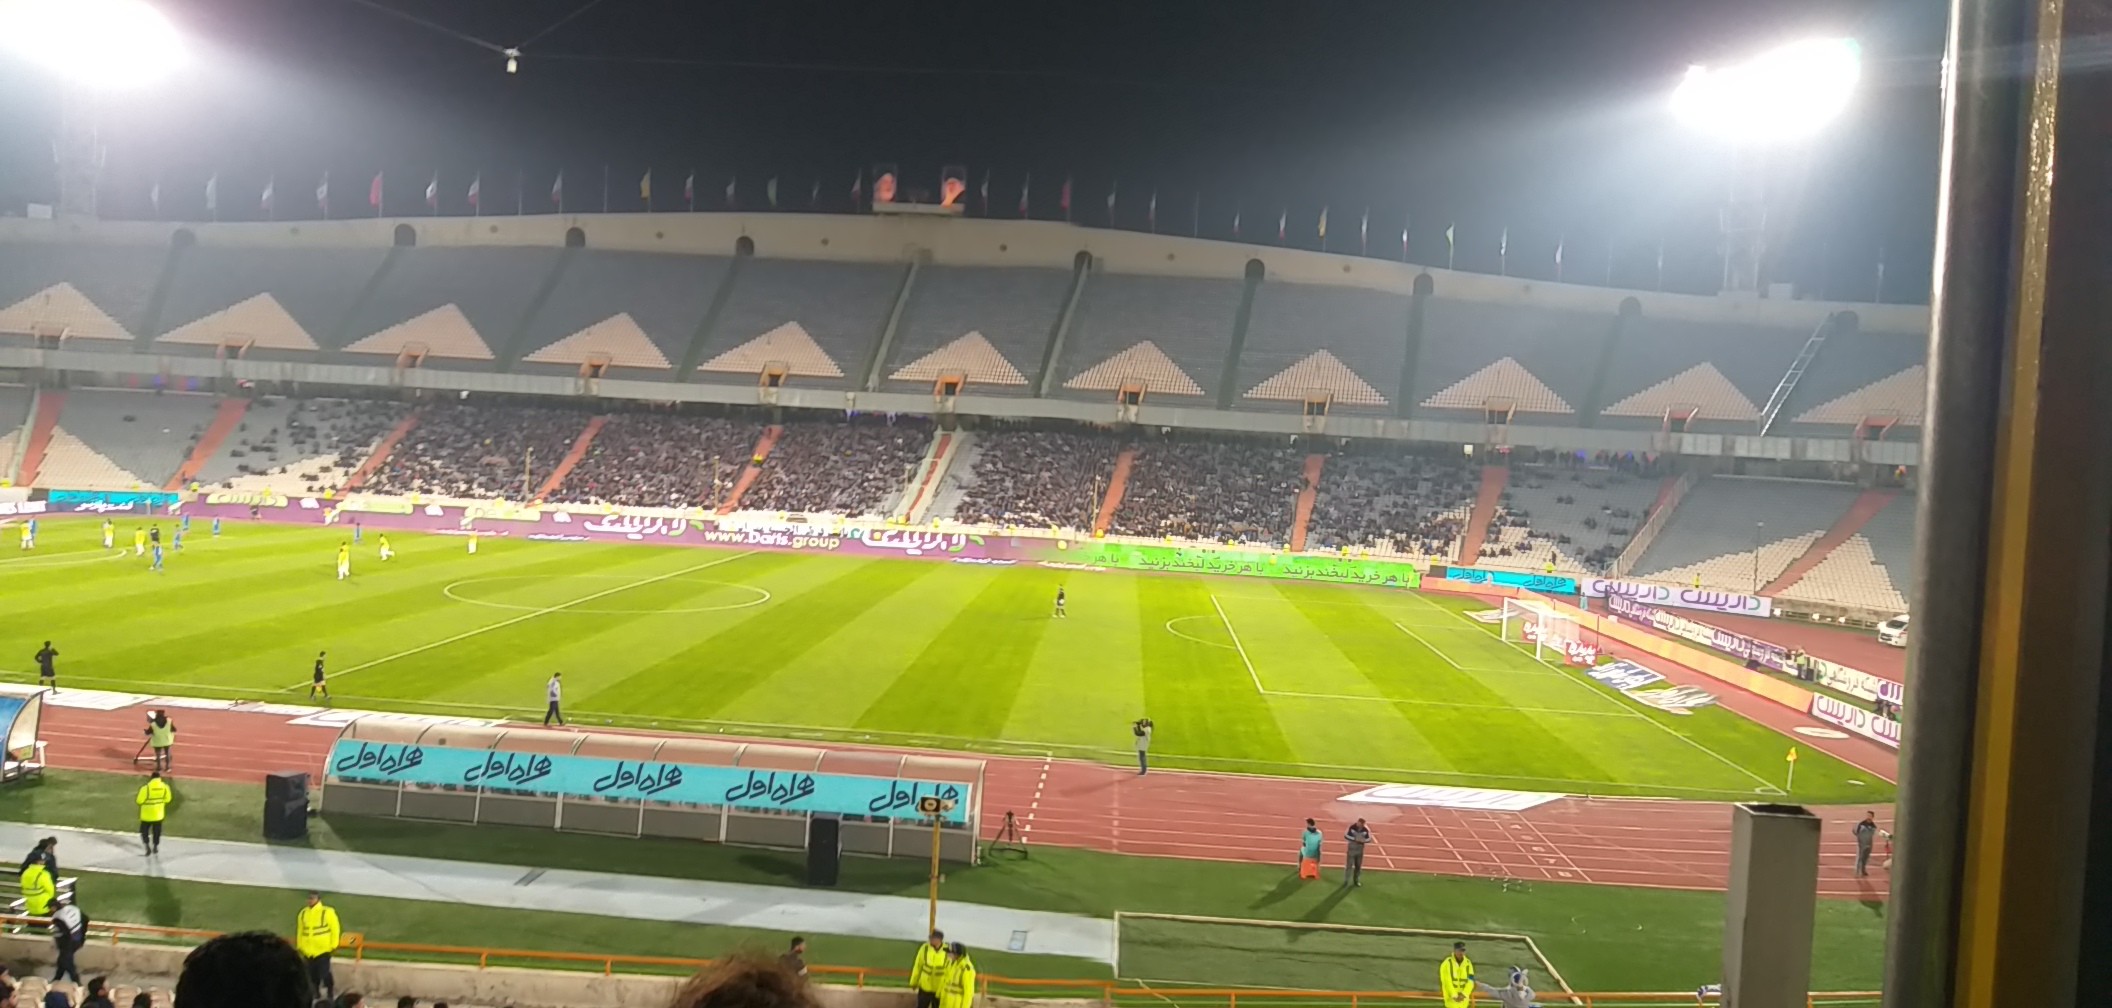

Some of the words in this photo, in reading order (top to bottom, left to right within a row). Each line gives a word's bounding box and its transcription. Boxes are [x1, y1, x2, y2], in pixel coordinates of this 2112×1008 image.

[336, 741, 388, 772] اول
[464, 751, 516, 782] اول
[593, 760, 645, 792] اول
[725, 769, 776, 802] اول
